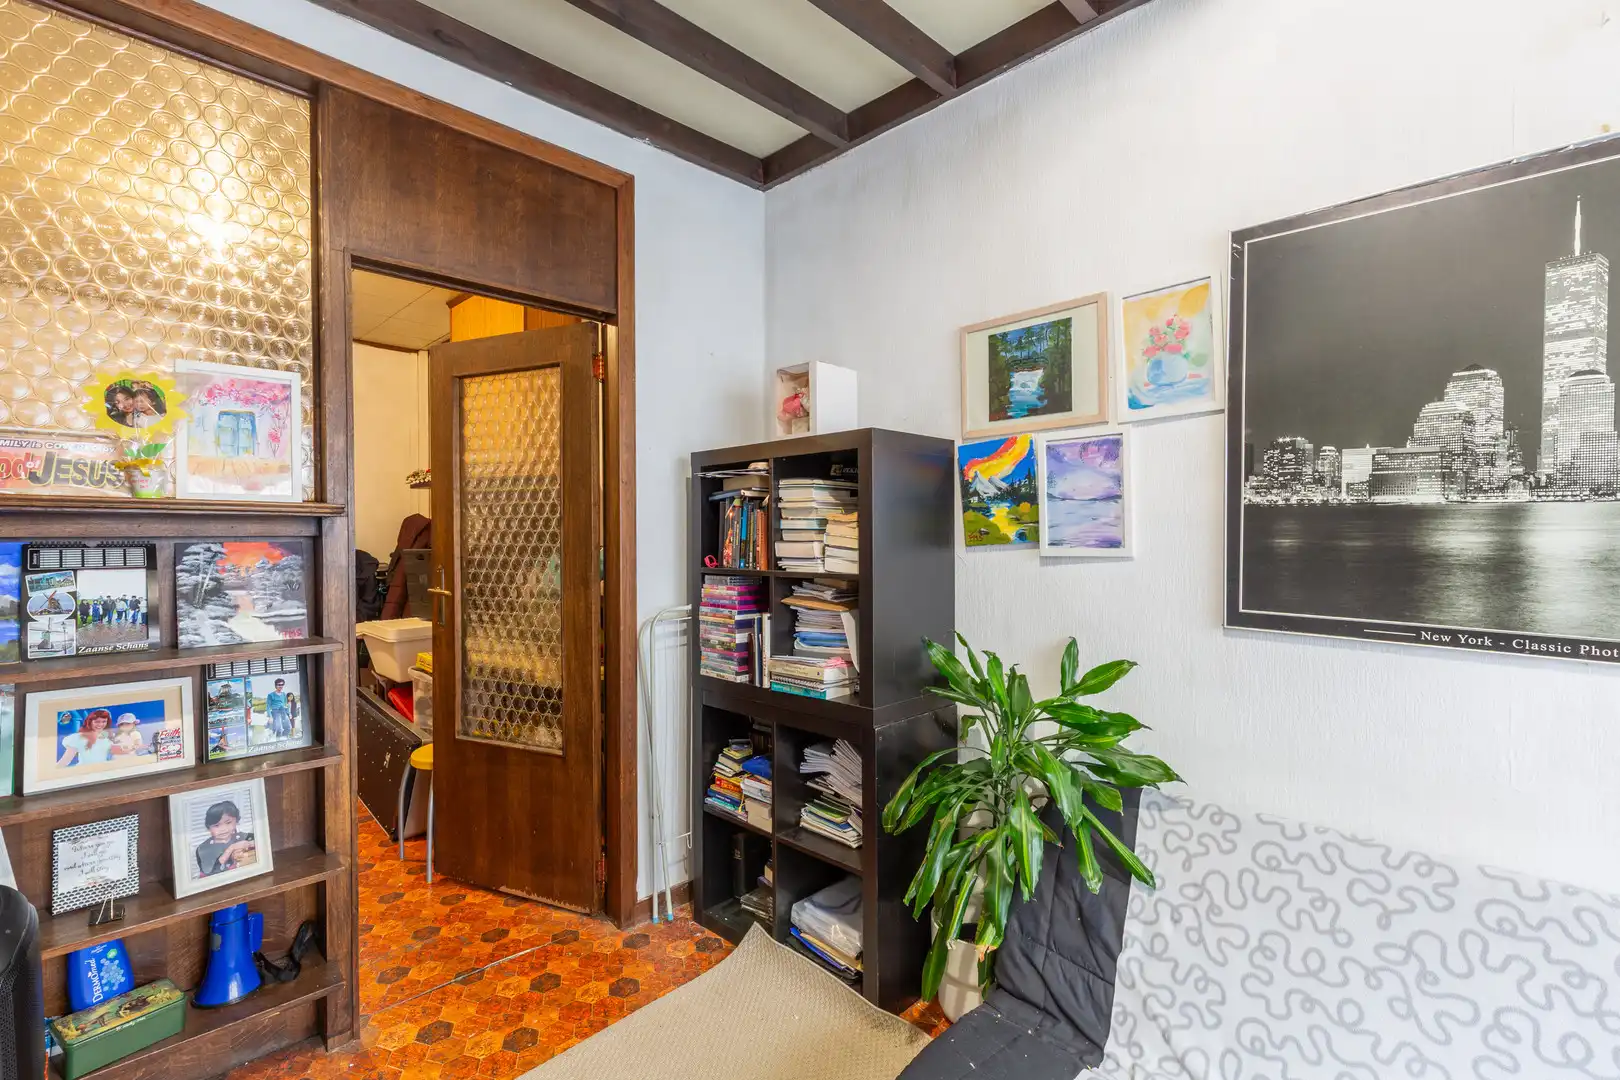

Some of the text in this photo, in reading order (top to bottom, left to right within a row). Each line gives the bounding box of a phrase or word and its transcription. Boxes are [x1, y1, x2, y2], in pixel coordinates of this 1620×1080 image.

[28, 450, 124, 488] JESUS
[78, 642, 149, 654] Zaanse Schans
[1420, 630, 1452, 643] New
[1457, 633, 1493, 647] York
[1512, 638, 1572, 654] Classic
